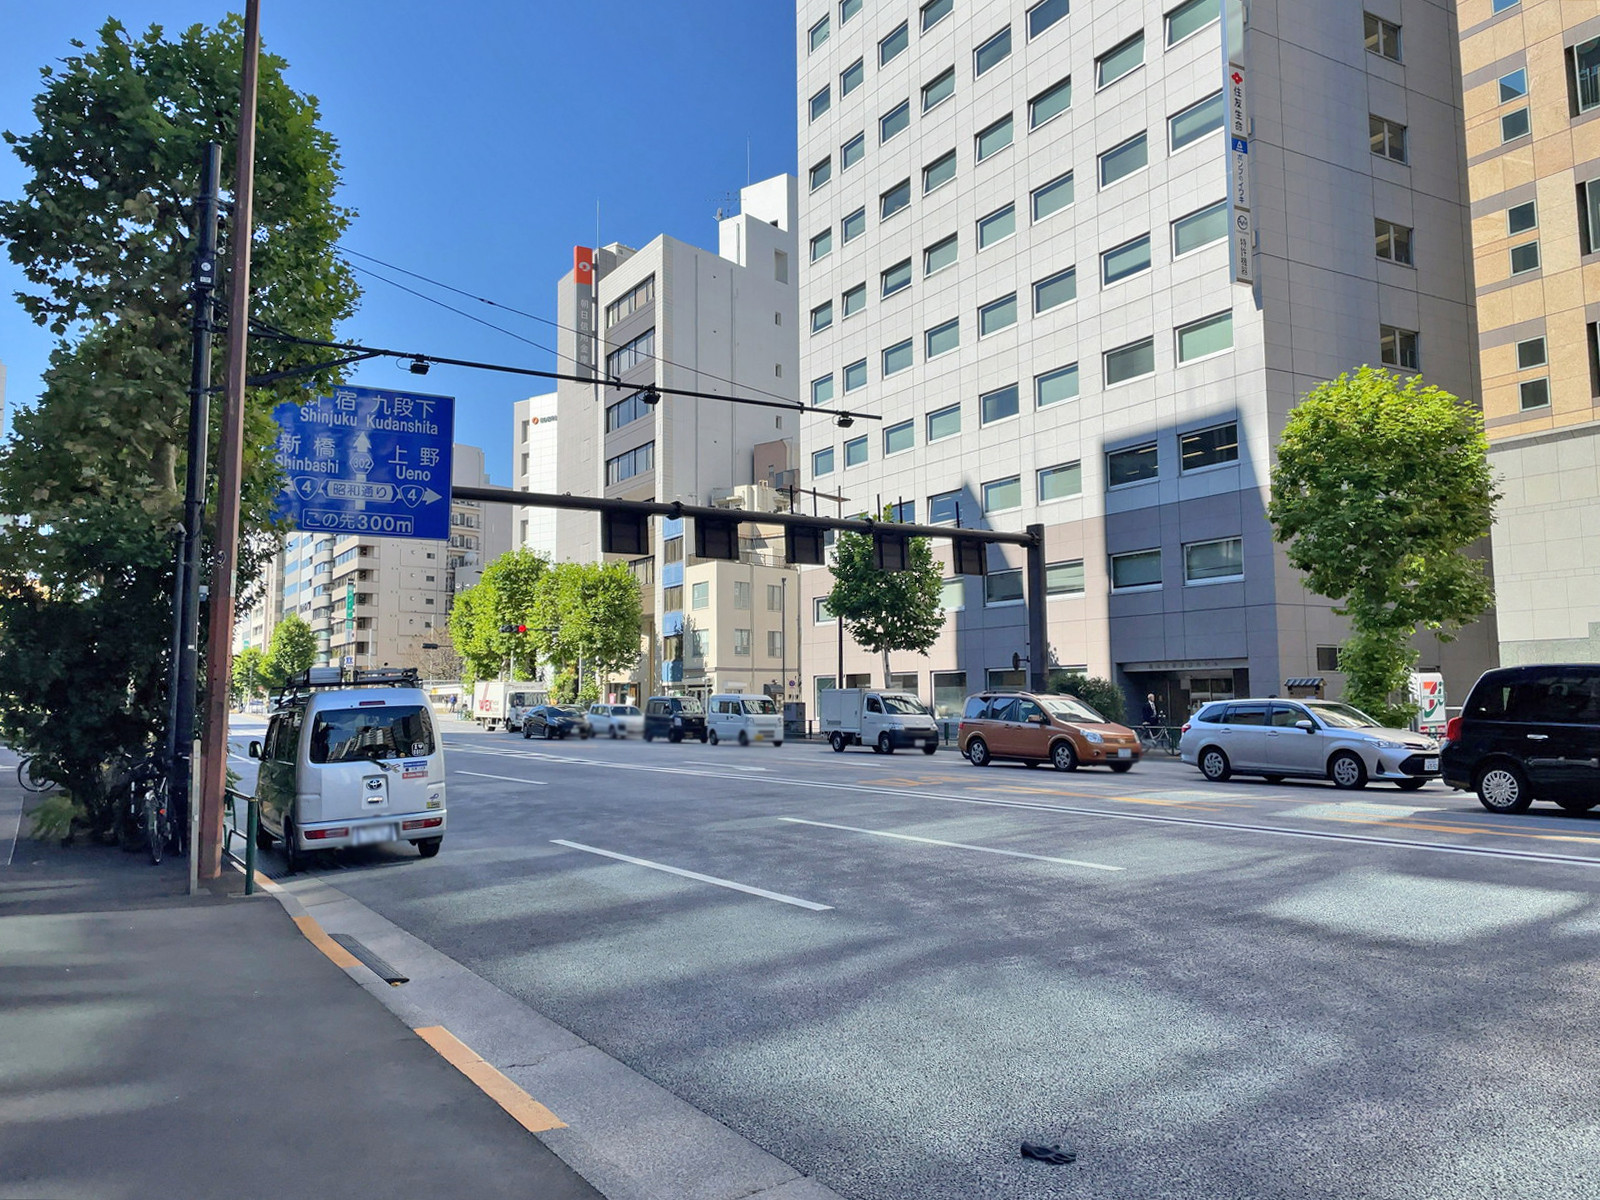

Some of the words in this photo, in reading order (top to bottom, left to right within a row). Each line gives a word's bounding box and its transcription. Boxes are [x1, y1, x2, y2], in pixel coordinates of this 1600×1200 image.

[1233, 86, 1243, 132] 住友生命
[580, 299, 589, 365] 朝日信用金庫
[371, 394, 436, 419] 九段下
[300, 407, 358, 427] Shinjuku
[366, 414, 439, 436] Kudanshita
[279, 433, 336, 458] 新橋
[275, 454, 340, 474] Shinbashi
[353, 457, 371, 470] 302
[388, 445, 440, 467] 上野
[396, 465, 432, 482] Ueno
[301, 480, 312, 494] 4
[332, 482, 388, 499] 昭和通り
[407, 491, 418, 502] 4
